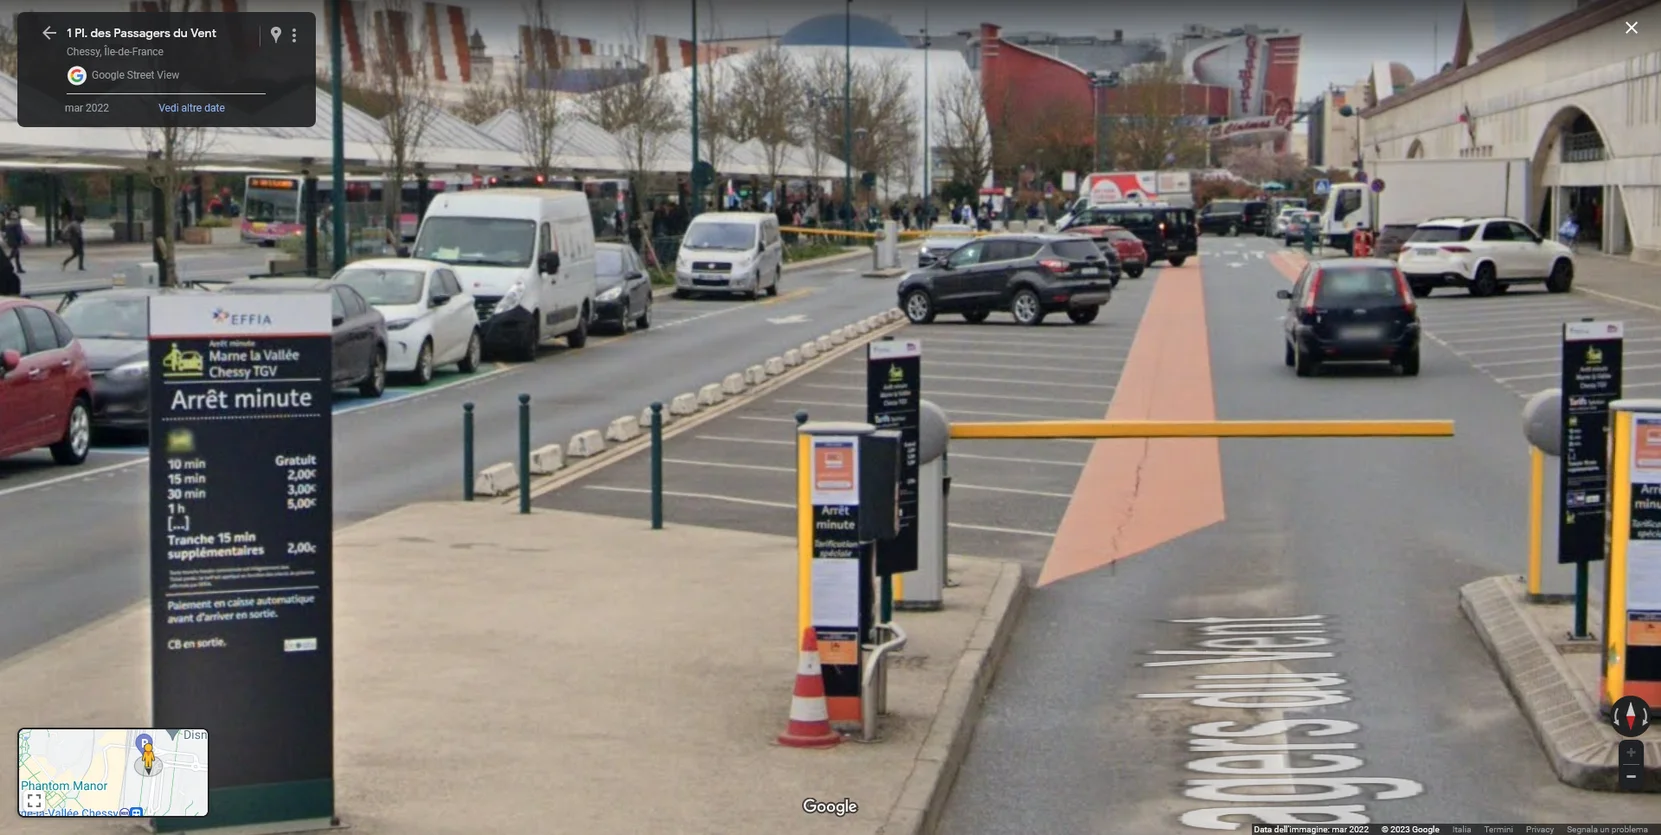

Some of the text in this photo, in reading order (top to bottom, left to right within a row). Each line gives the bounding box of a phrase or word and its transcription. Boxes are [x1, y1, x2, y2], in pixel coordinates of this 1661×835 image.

[231, 314, 272, 325] EFFIA
[209, 349, 299, 361] Marne la Vallée
[209, 366, 278, 379] Chessy TGV
[170, 387, 312, 410] Arrêt minute
[168, 458, 206, 470] 10 min
[275, 455, 317, 466] Gratuit
[168, 473, 206, 484] 15 min
[168, 488, 206, 499] 30 min
[168, 503, 185, 514] 1 h
[821, 505, 850, 516] Arrêt
[816, 520, 856, 530] minute
[168, 532, 256, 546] Tranche 15 min
[168, 547, 265, 561] supplémentaires
[168, 594, 315, 610] Paiement en caisse automatique
[168, 614, 194, 623] avant
[196, 611, 234, 622] d'arriver
[249, 609, 278, 619] sortie.
[168, 638, 227, 649] CB en sortie.
